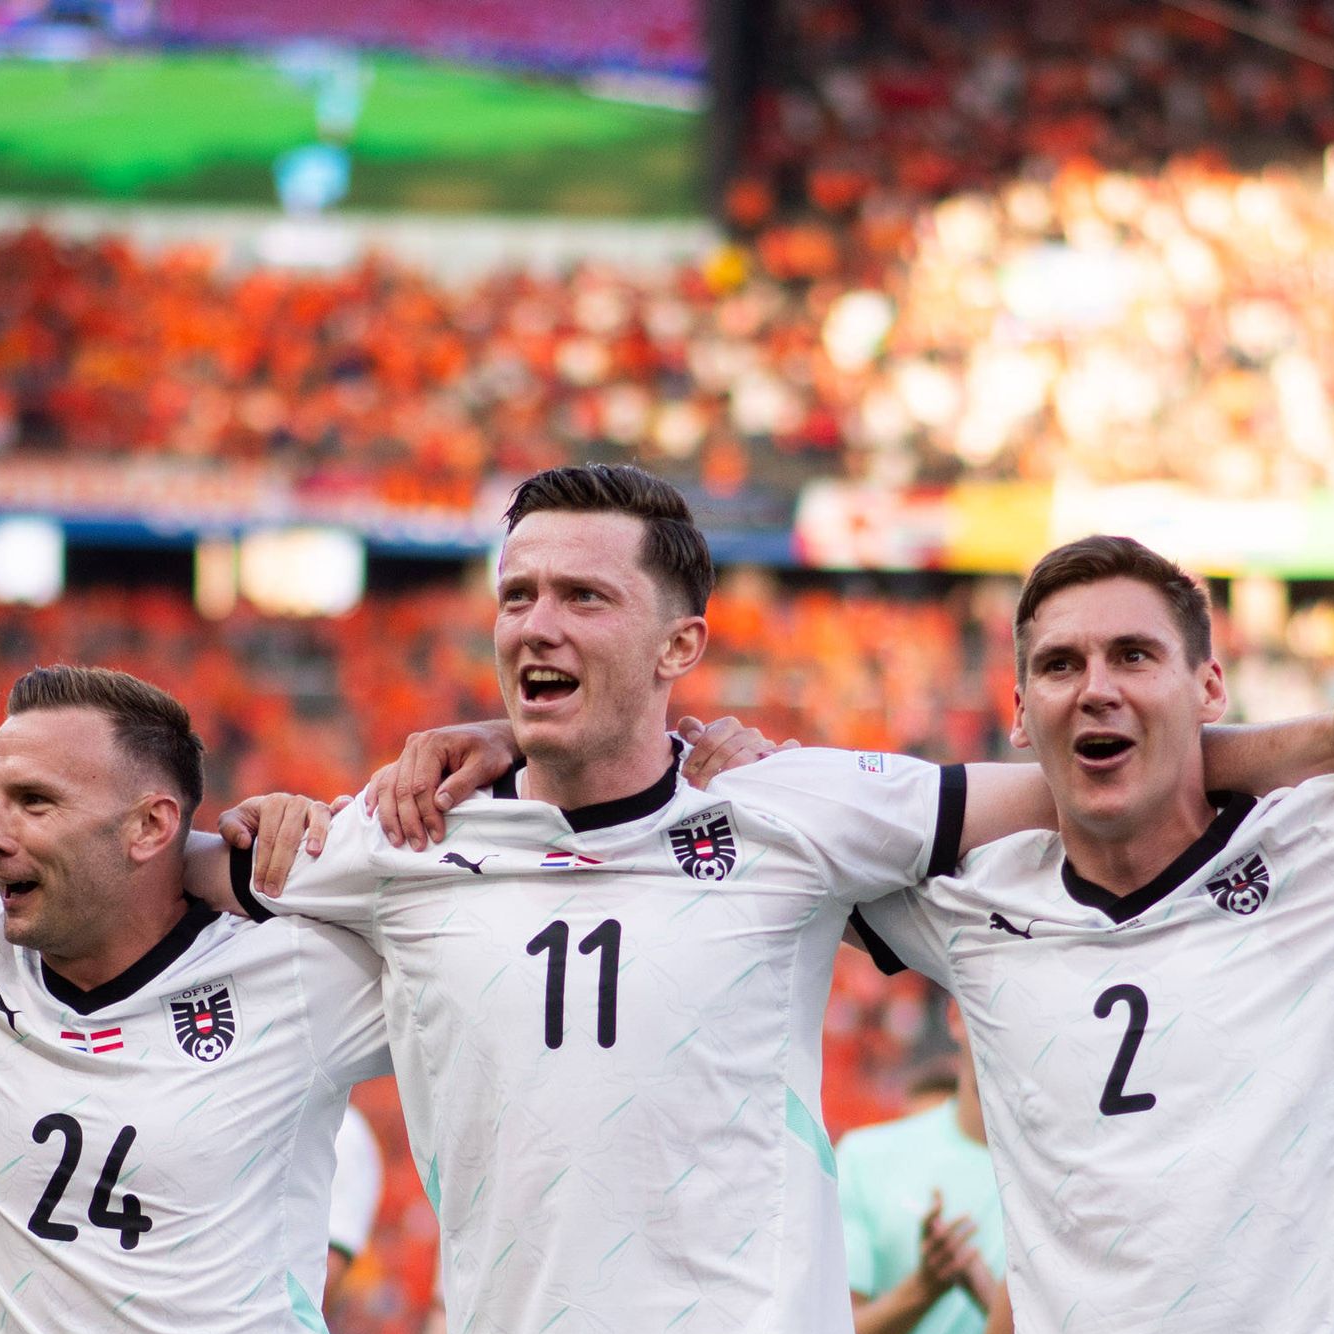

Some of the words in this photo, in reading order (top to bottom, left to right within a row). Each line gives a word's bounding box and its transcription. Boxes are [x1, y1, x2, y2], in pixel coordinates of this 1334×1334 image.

[527, 919, 621, 1049] 11
[1094, 984, 1156, 1116] 2
[28, 1113, 152, 1250] 24
